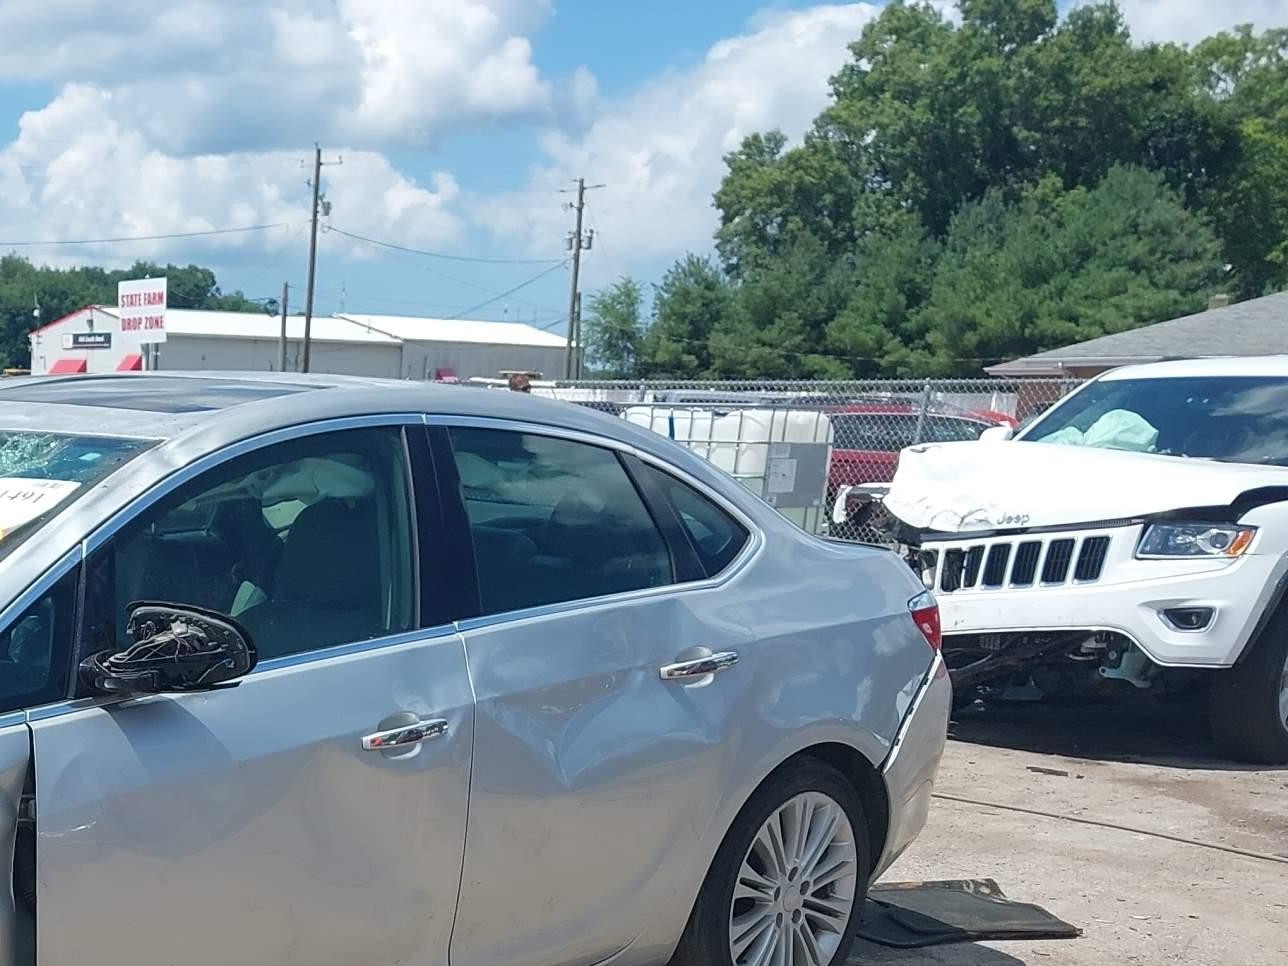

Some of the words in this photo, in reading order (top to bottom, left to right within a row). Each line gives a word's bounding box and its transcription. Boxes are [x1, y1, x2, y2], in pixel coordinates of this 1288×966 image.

[121, 293, 141, 307] STATE
[144, 291, 164, 305] FARM
[121, 317, 142, 331] DROP
[144, 316, 164, 329] ZONE
[996, 512, 1030, 526] Jeep
